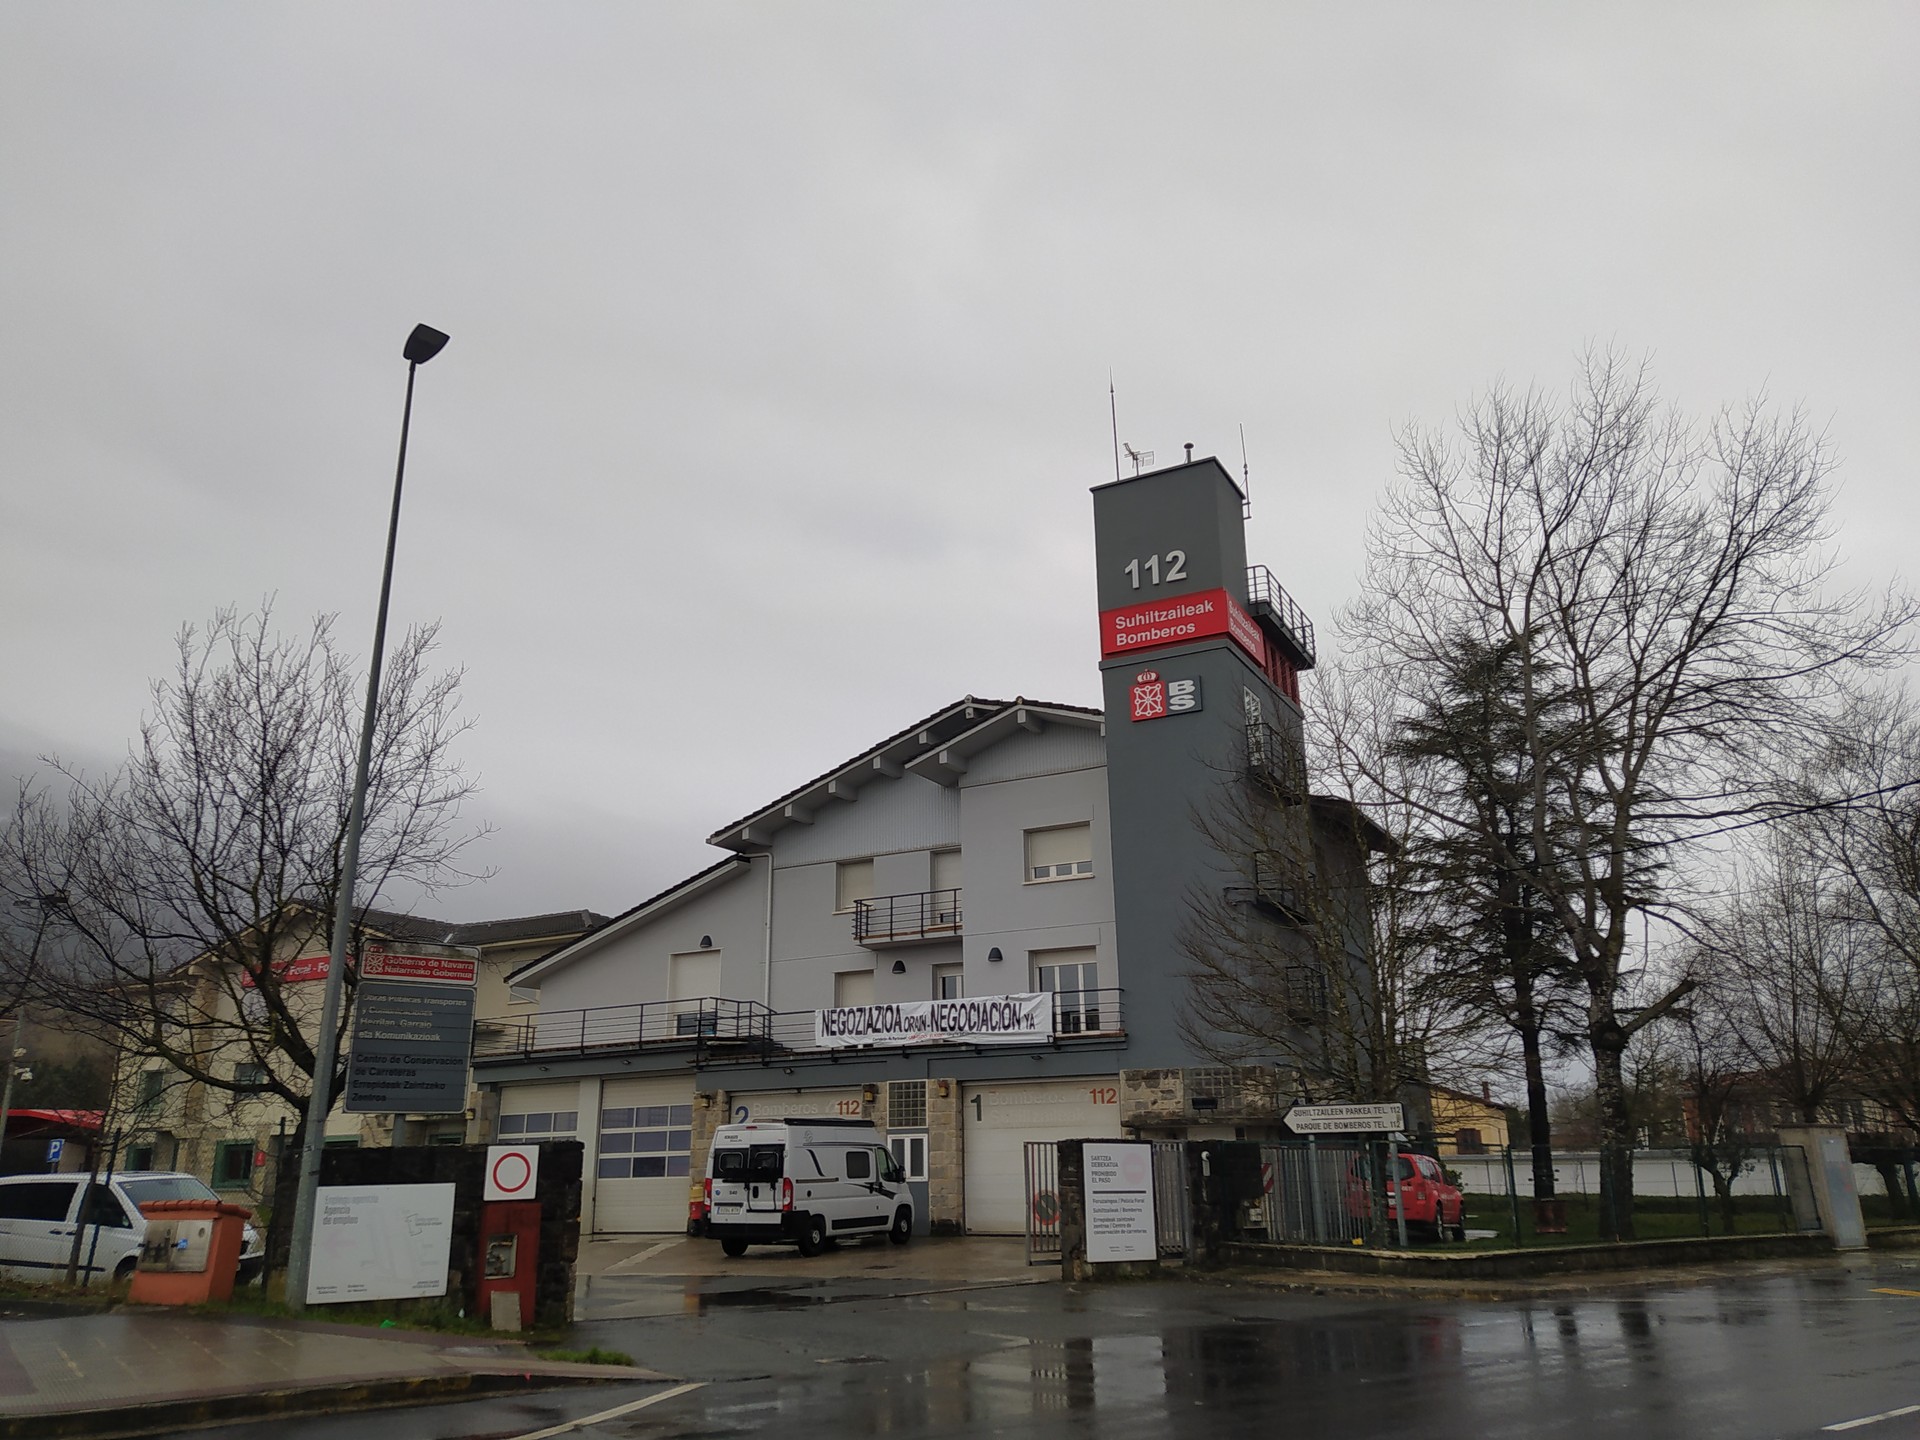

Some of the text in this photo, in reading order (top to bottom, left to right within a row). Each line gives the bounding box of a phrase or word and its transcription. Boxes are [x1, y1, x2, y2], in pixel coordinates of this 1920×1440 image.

[1124, 550, 1188, 589] 112
[1115, 600, 1214, 630] Suhiltzaileak
[1116, 622, 1196, 647] Bomberos
[386, 956, 427, 967] Gobierno
[441, 961, 474, 970] Navarra
[432, 969, 473, 979] Gobernua
[821, 1004, 902, 1038] NEGOZIAZIOA
[931, 996, 1022, 1032] NEGOCIACIÓN
[1023, 1014, 1036, 1030] YA
[356, 1054, 388, 1064] Centro
[389, 1056, 401, 1064] de
[1089, 1088, 1118, 1104] 112
[734, 1103, 818, 1124] 2 Bomberos
[836, 1100, 860, 1117] 112
[970, 1094, 982, 1121] 1
[1293, 1108, 1343, 1117] SUHILTZAILEEN
[1345, 1106, 1371, 1115] PARKEA
[1390, 1105, 1401, 1113] 112
[1296, 1122, 1320, 1130] PARQUE
[1334, 1121, 1371, 1129] BOMBEROS
[1390, 1119, 1401, 1128] 112
[49, 1142, 60, 1158] P
